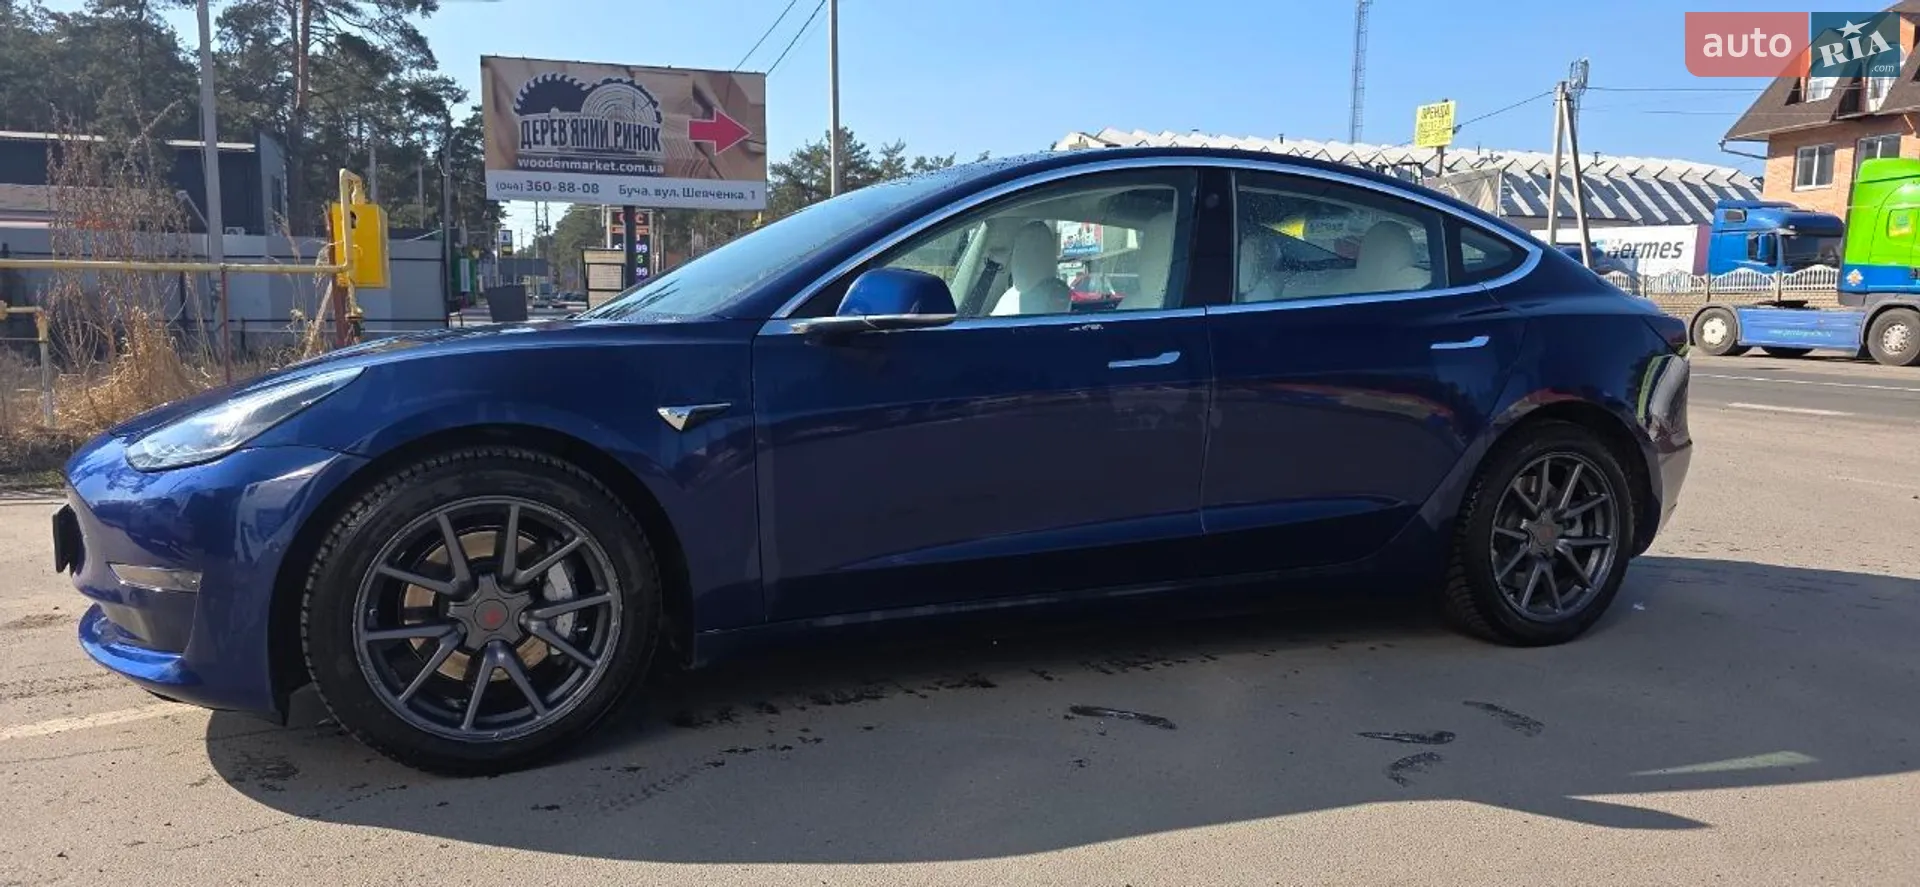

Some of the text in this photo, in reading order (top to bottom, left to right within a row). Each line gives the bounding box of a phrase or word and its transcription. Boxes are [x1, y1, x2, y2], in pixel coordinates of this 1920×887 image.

[614, 121, 661, 152] РИНОК
[518, 158, 664, 173] woodenmarket.com.ua
[526, 180, 600, 194] 360-88-08
[654, 188, 679, 199] вул.
[750, 190, 757, 199] 1
